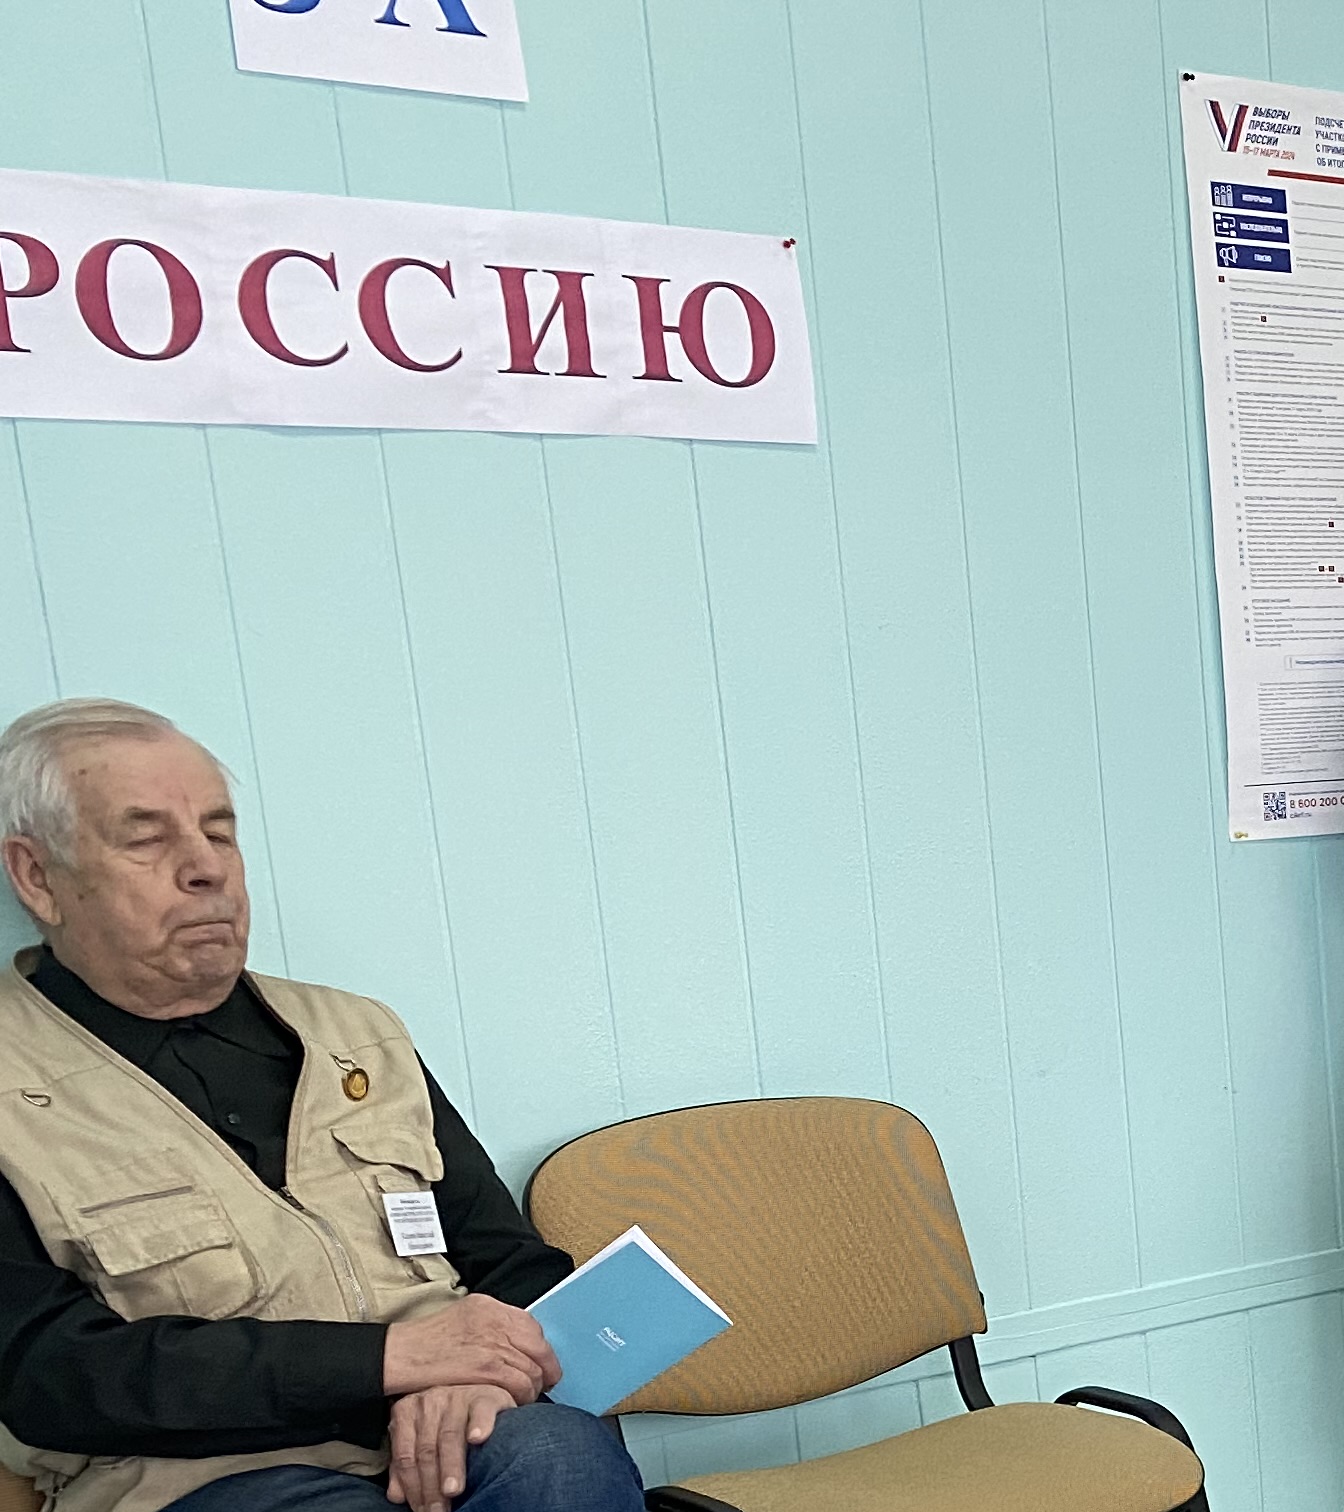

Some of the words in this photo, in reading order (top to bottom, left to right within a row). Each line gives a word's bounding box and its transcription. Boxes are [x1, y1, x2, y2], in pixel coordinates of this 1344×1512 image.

[1252, 106, 1290, 120] ВЫБОРЫ
[1248, 120, 1302, 136] ПРЕЗИДЕНТА
[1245, 133, 1279, 147] РОССИИ
[1316, 157, 1326, 166] ОБ
[0, 230, 776, 388] РОССИЮ
[1319, 797, 1338, 807] 200
